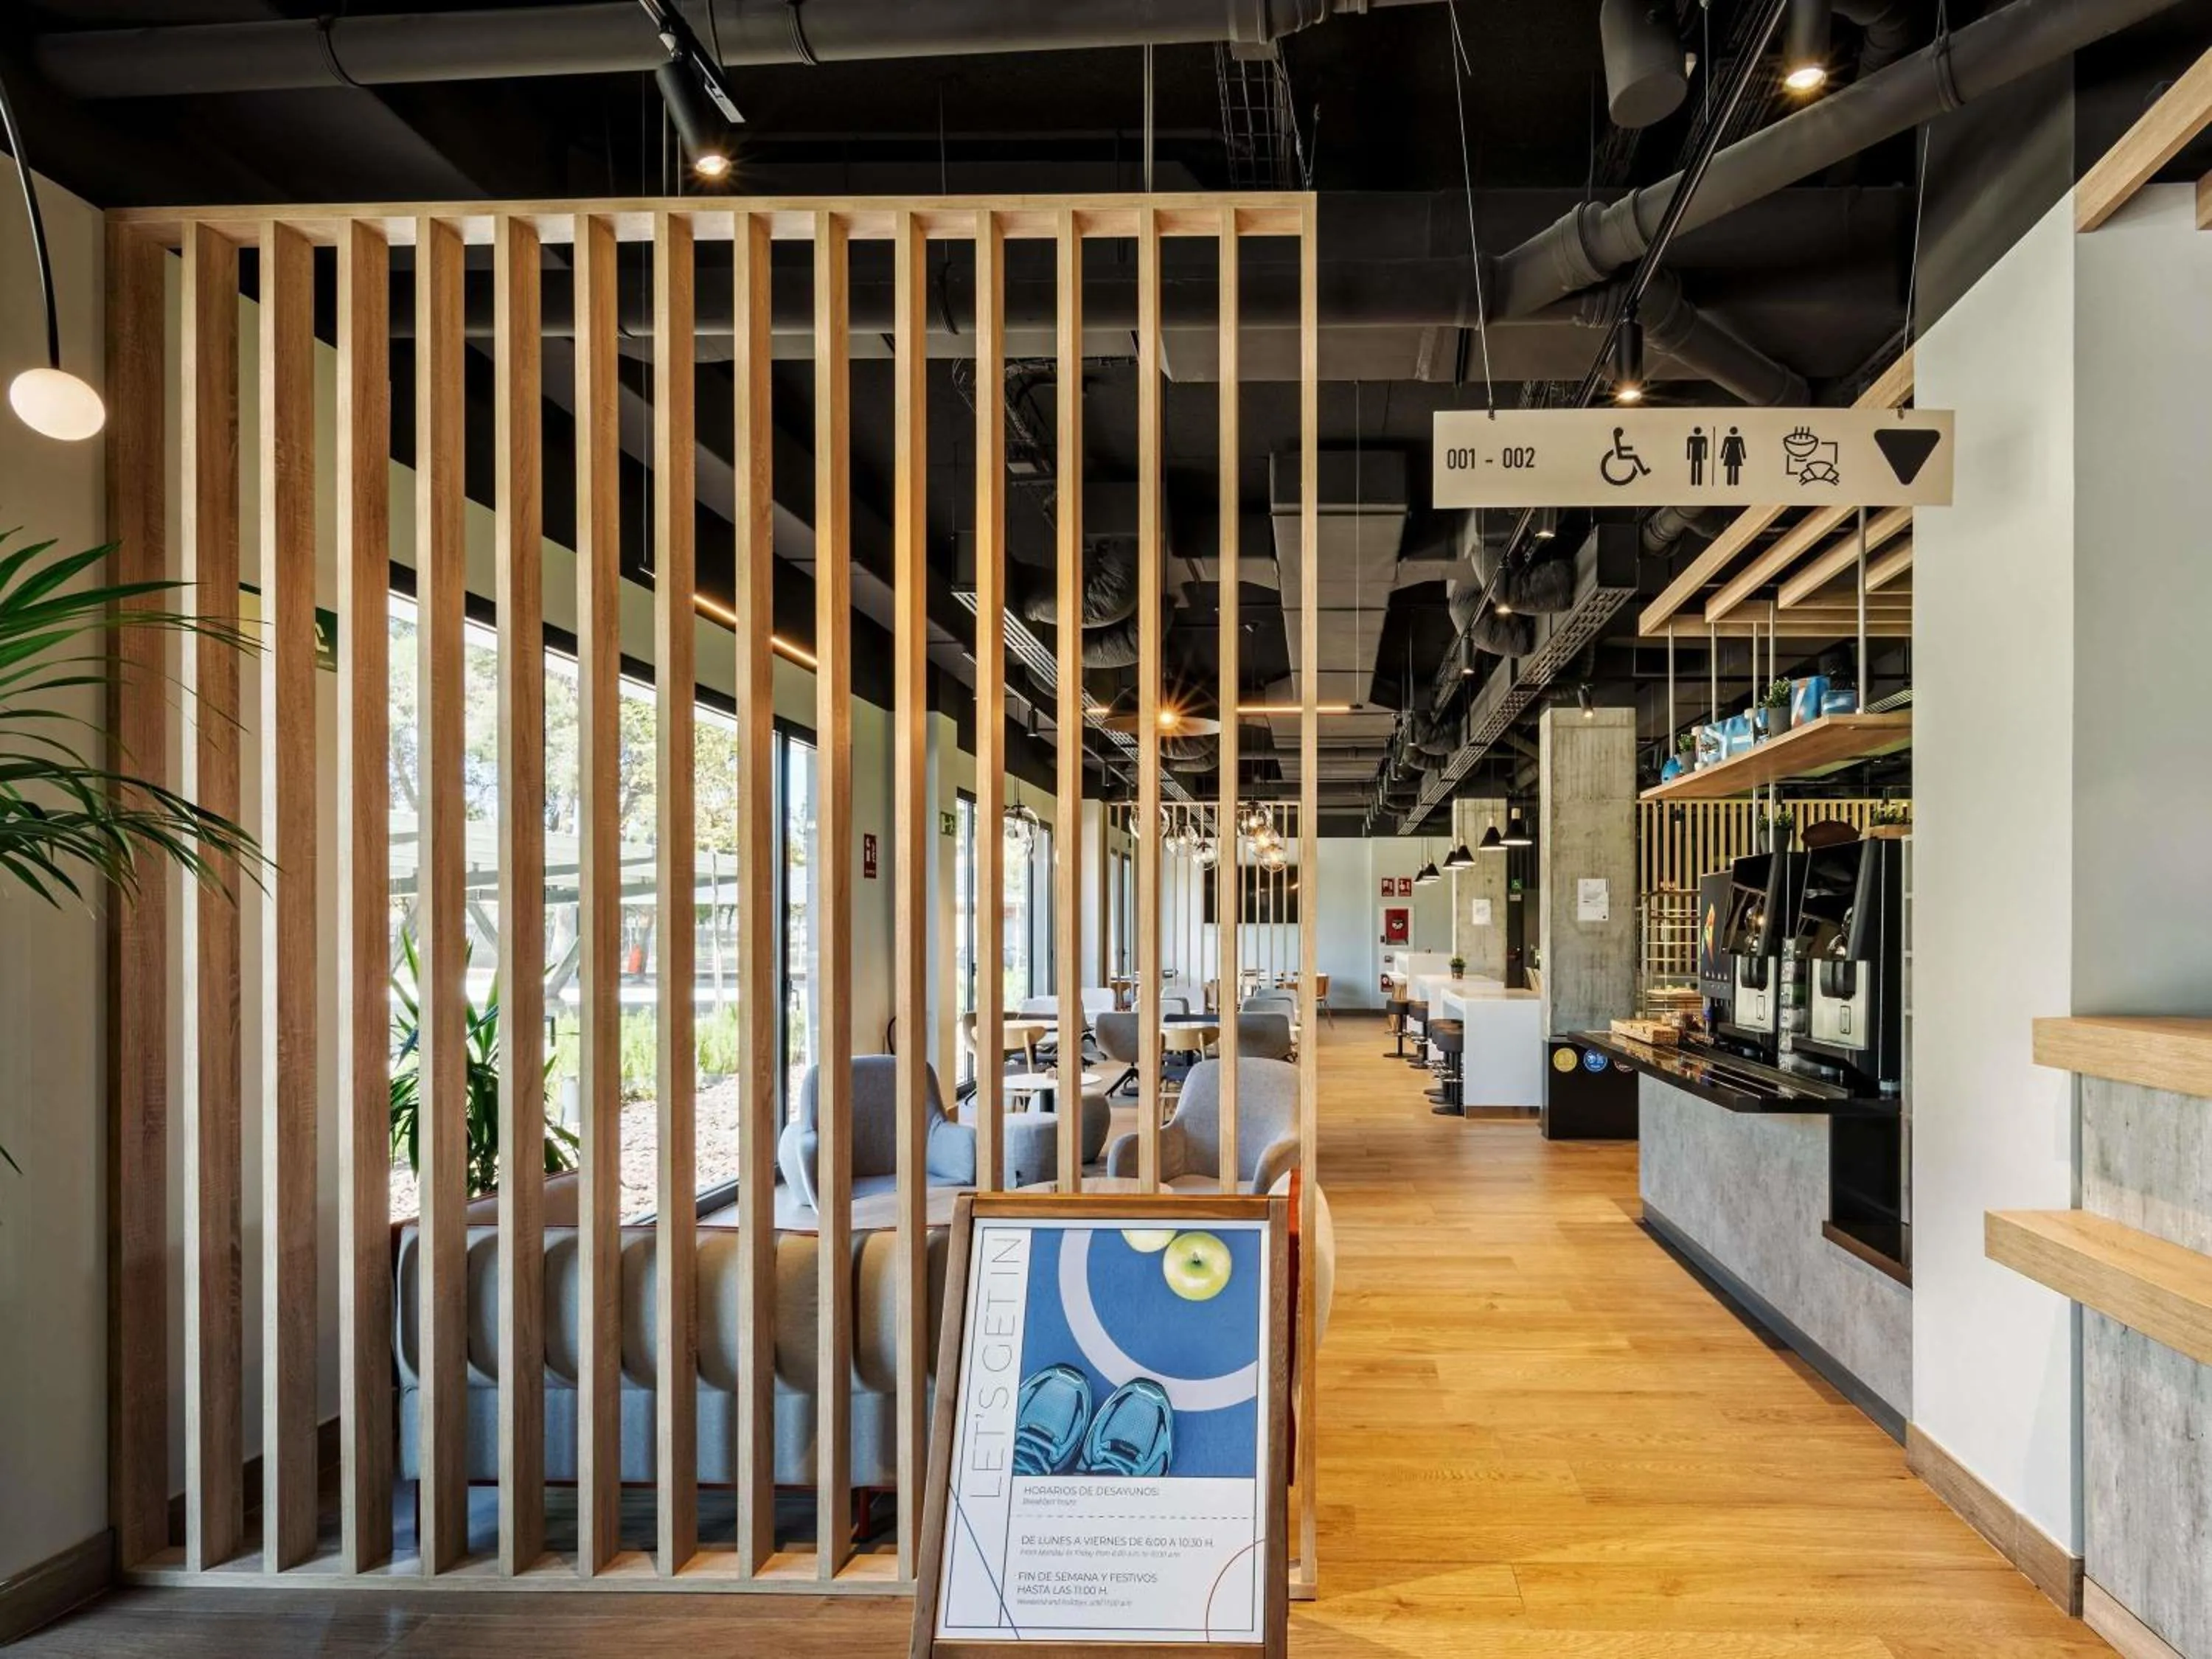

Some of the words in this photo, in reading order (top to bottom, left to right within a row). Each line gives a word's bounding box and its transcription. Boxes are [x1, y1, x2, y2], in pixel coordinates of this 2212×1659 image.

[1447, 448, 1475, 469] 001
[1503, 447, 1535, 468] 002
[990, 1238, 1022, 1275] IN
[982, 1289, 1018, 1372] GET
[970, 1385, 1009, 1497] LET'S
[1024, 1486, 1077, 1495] HORARIOS
[1079, 1486, 1095, 1496] DE
[1021, 1535, 1035, 1545] DE
[1037, 1535, 1072, 1545] LUNES
[1074, 1536, 1082, 1545] A
[1084, 1536, 1127, 1546] VIERNES
[1129, 1537, 1143, 1546] DE
[1169, 1537, 1176, 1547] A
[1018, 1571, 1034, 1582] FIN
[1037, 1571, 1052, 1582] DE
[1054, 1571, 1099, 1582] SEMANA
[1101, 1572, 1108, 1582] Y
[1110, 1573, 1158, 1583] FESTIVOS
[1017, 1585, 1051, 1594] HASTA
[1052, 1585, 1073, 1595] LAS
